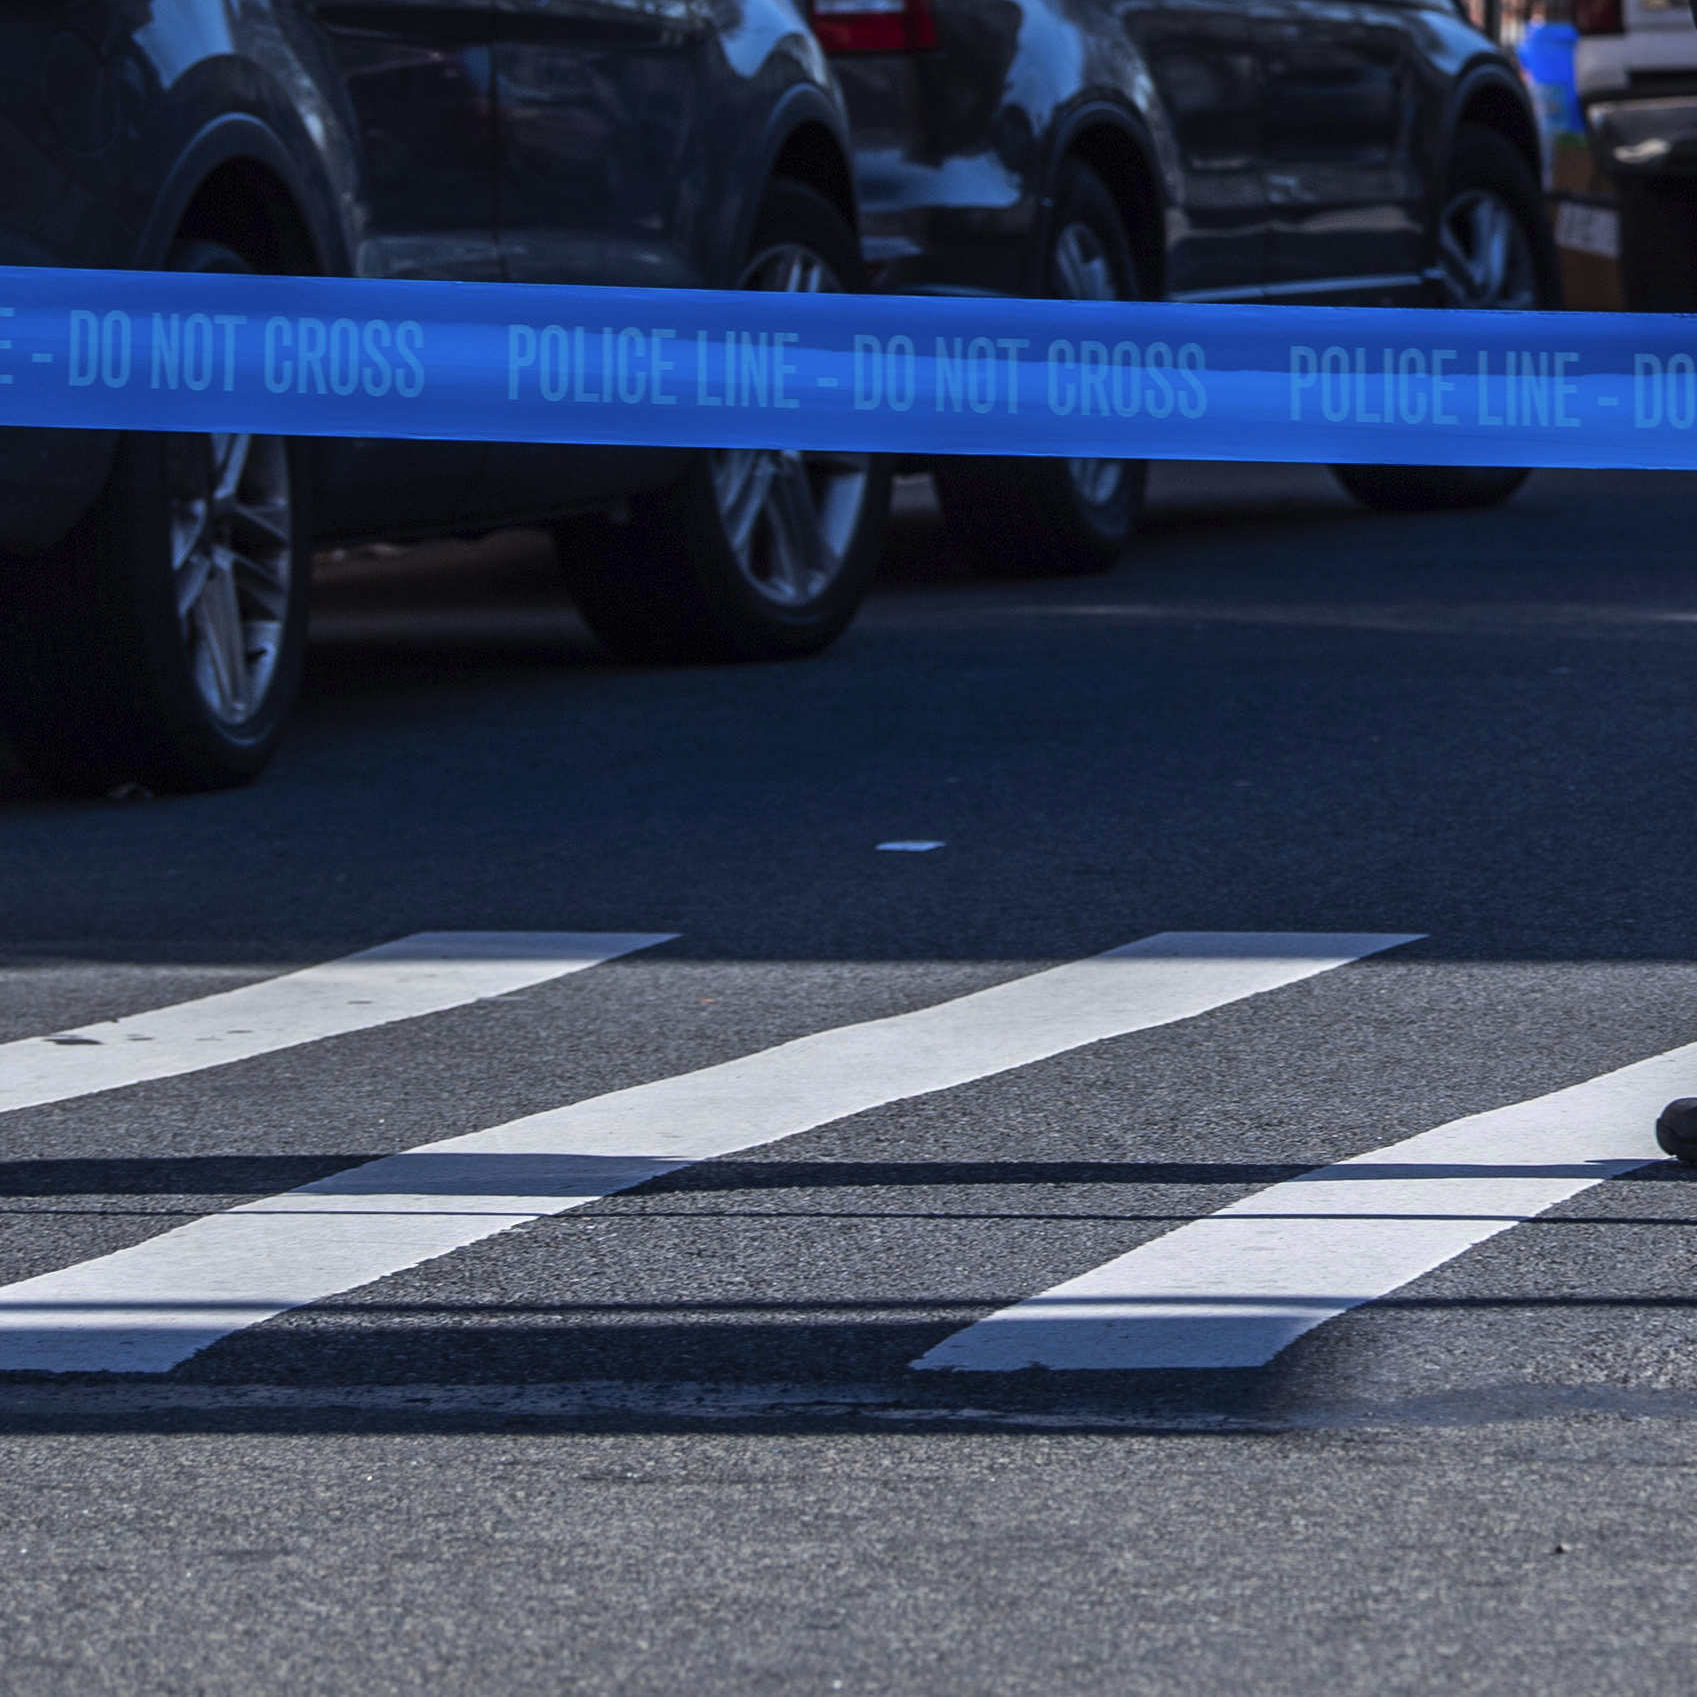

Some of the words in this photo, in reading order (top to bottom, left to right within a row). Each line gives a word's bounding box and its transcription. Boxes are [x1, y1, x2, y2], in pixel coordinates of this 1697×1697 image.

[68, 309, 131, 389] DO
[150, 311, 248, 392] NOT
[264, 315, 425, 398] CROSS
[508, 323, 677, 405] POLICE
[697, 329, 800, 409] LINE
[853, 334, 915, 412] DO
[935, 336, 1030, 414] NOT
[1047, 339, 1207, 419] CROSS
[1290, 345, 1458, 425] POLICE
[1477, 350, 1581, 428] LINE
[1634, 353, 1696, 430] DO
